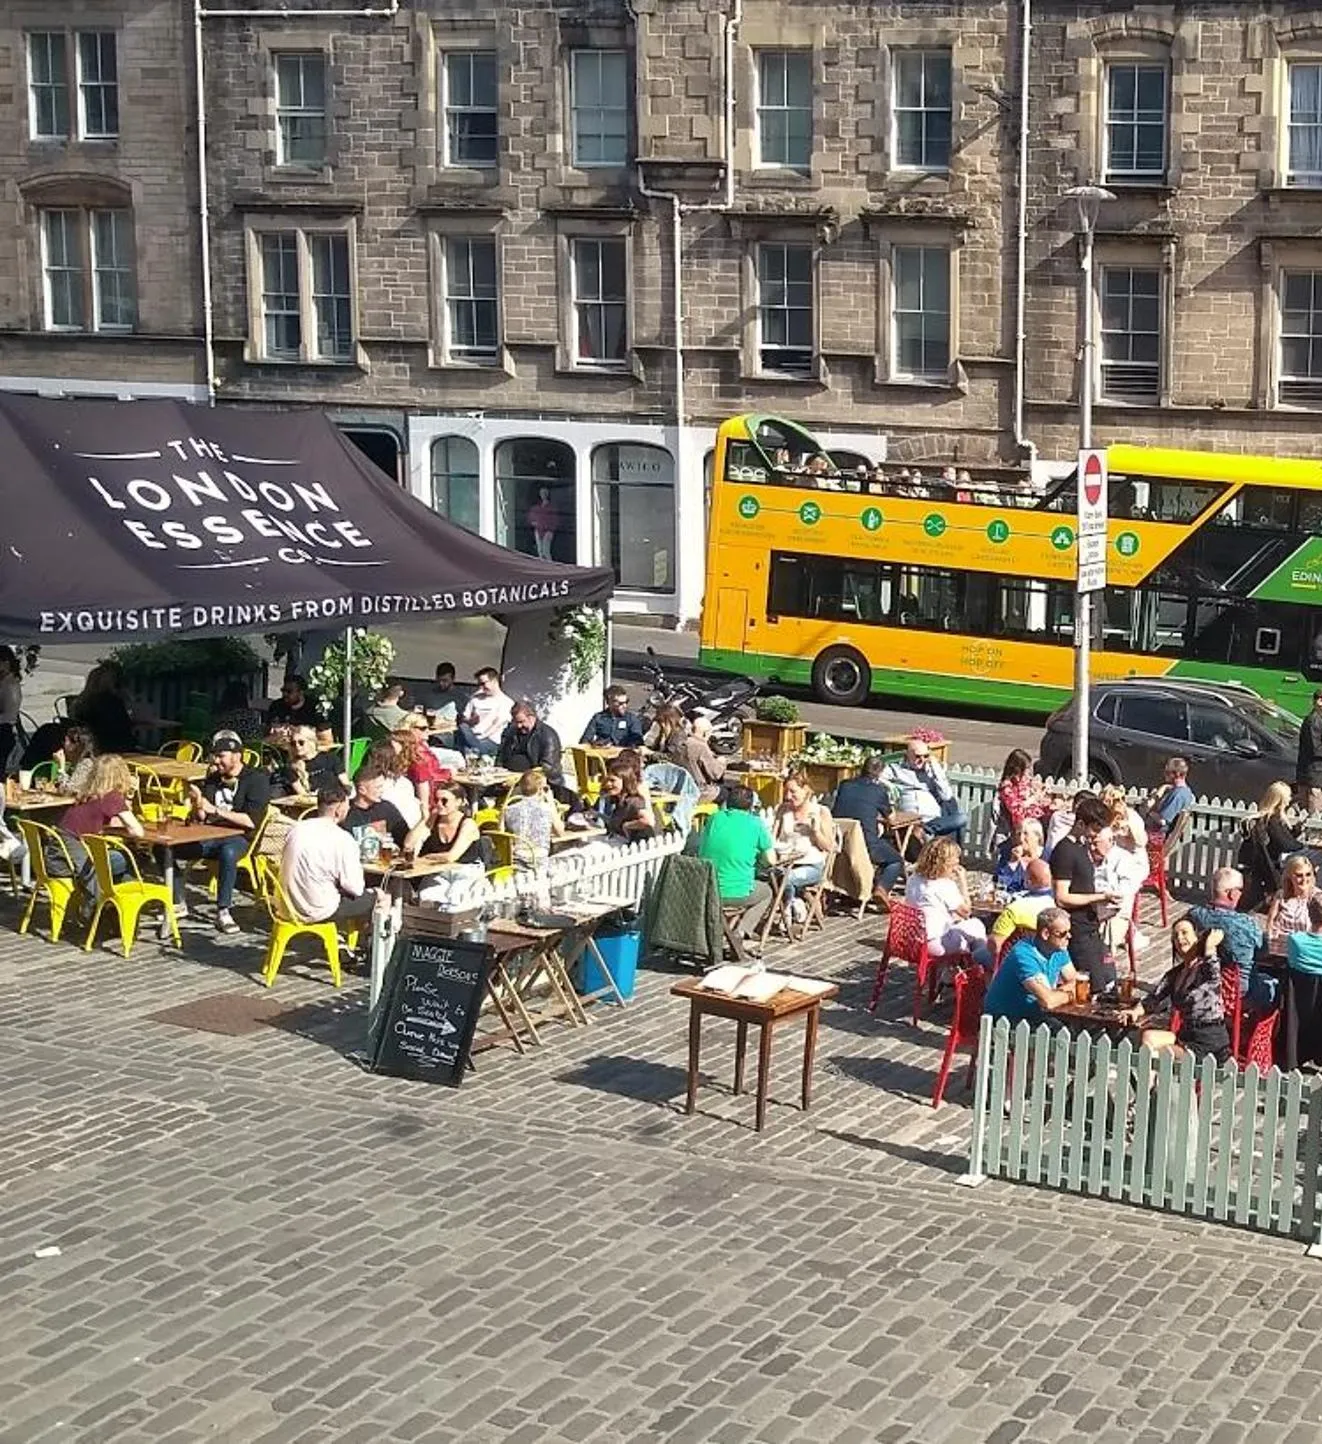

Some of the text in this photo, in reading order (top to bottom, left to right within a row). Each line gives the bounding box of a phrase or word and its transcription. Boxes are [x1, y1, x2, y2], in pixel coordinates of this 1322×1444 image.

[167, 437, 229, 463] THE
[88, 471, 340, 512] LONDON
[123, 508, 373, 549] ESSENCE
[39, 579, 570, 632] EXQUISITE DRINKS FROM DISTILLED BOTANICALS
